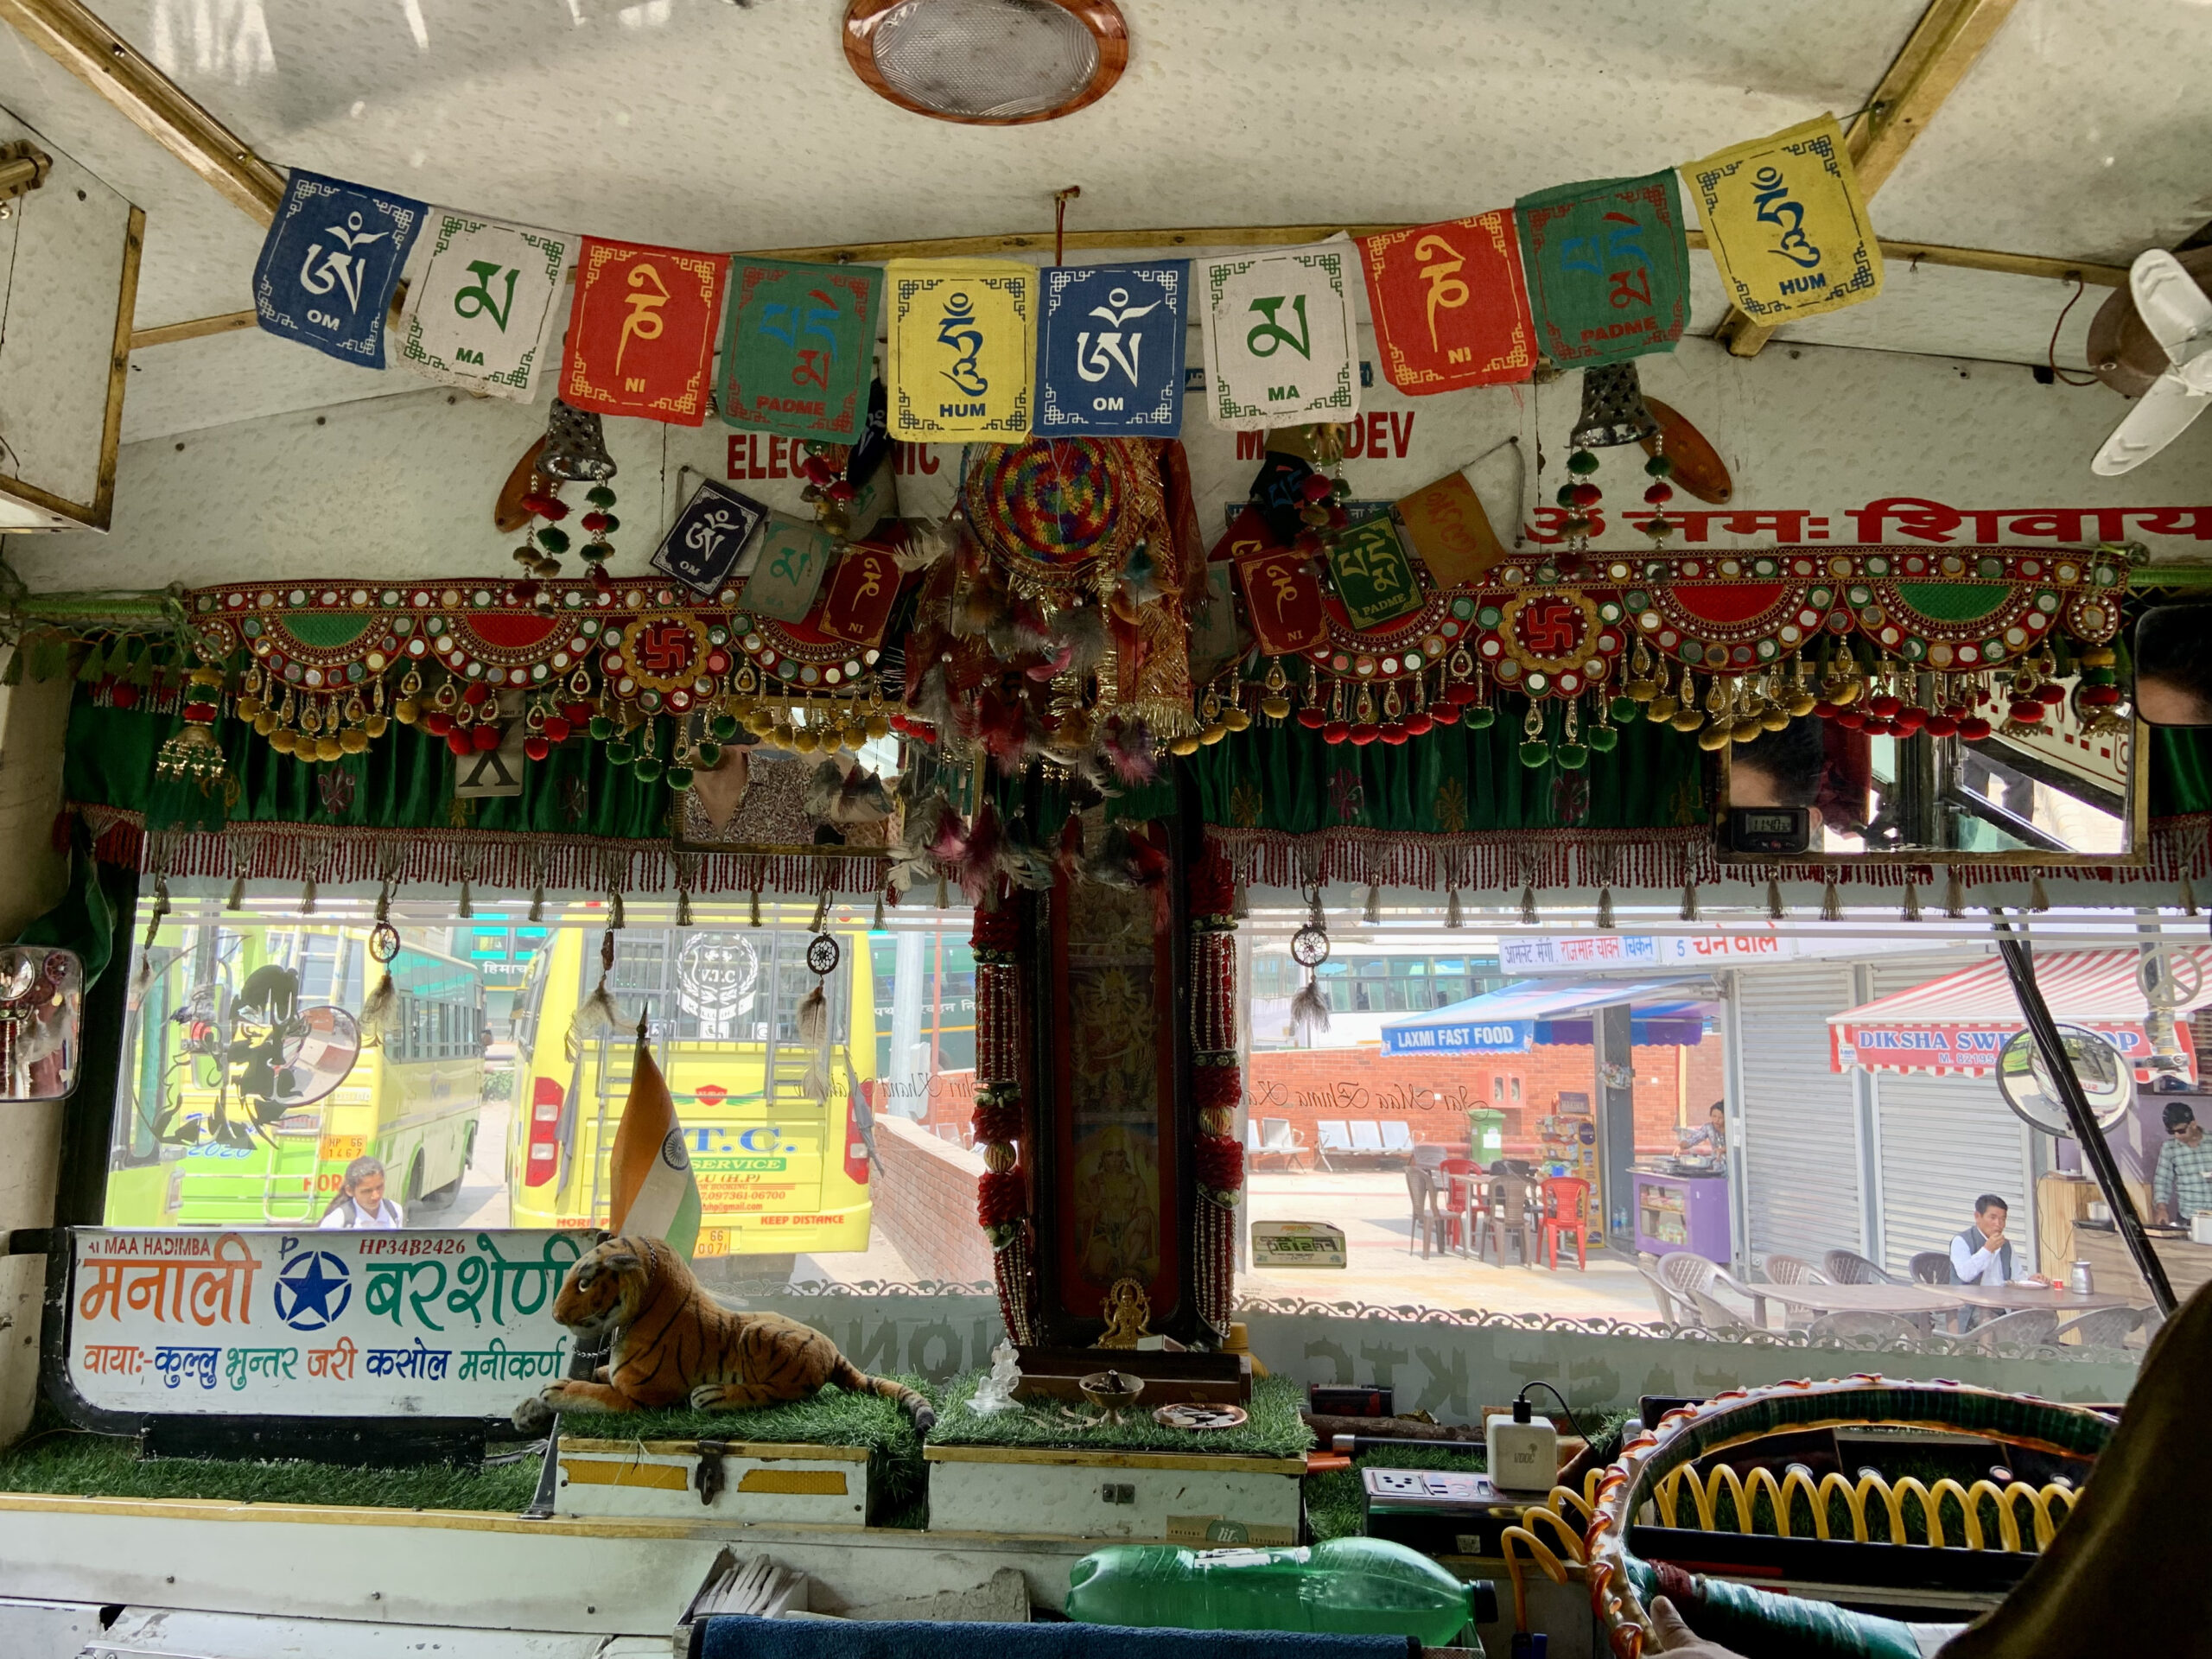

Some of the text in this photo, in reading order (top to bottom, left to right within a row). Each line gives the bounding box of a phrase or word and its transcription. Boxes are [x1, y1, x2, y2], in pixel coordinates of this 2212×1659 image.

[1779, 273, 1826, 296] HUM
[307, 310, 340, 332] OM
[1581, 316, 1657, 343] PADME
[455, 348, 485, 366] MA
[1447, 347, 1471, 364] NI
[625, 378, 646, 392] NI
[1268, 385, 1300, 401] MA
[756, 396, 826, 416] PADME
[939, 403, 987, 417] HUM
[1092, 397, 1124, 411] OM
[680, 560, 702, 576] OM
[1361, 593, 1407, 616] PADME
[849, 622, 865, 633] NI
[1287, 631, 1303, 641] NI
[1397, 1026, 1514, 1048] LAXMI FAST FOOD
[1859, 1031, 1948, 1051] DIKSHA
[1956, 1032, 2012, 1051] SWE
[1939, 1053, 1998, 1065] M. 82195
[350, 1137, 362, 1146] 66
[760, 1215, 844, 1225] KEEP DISTANCE
[710, 1231, 723, 1242] 66
[105, 1236, 138, 1255] MAA
[144, 1237, 210, 1256] HADIMBA
[359, 1238, 466, 1256] HP34B2426
[80, 1232, 263, 1327] मनाली
[308, 1336, 359, 1381] जरी
[366, 1337, 452, 1381] कसोल
